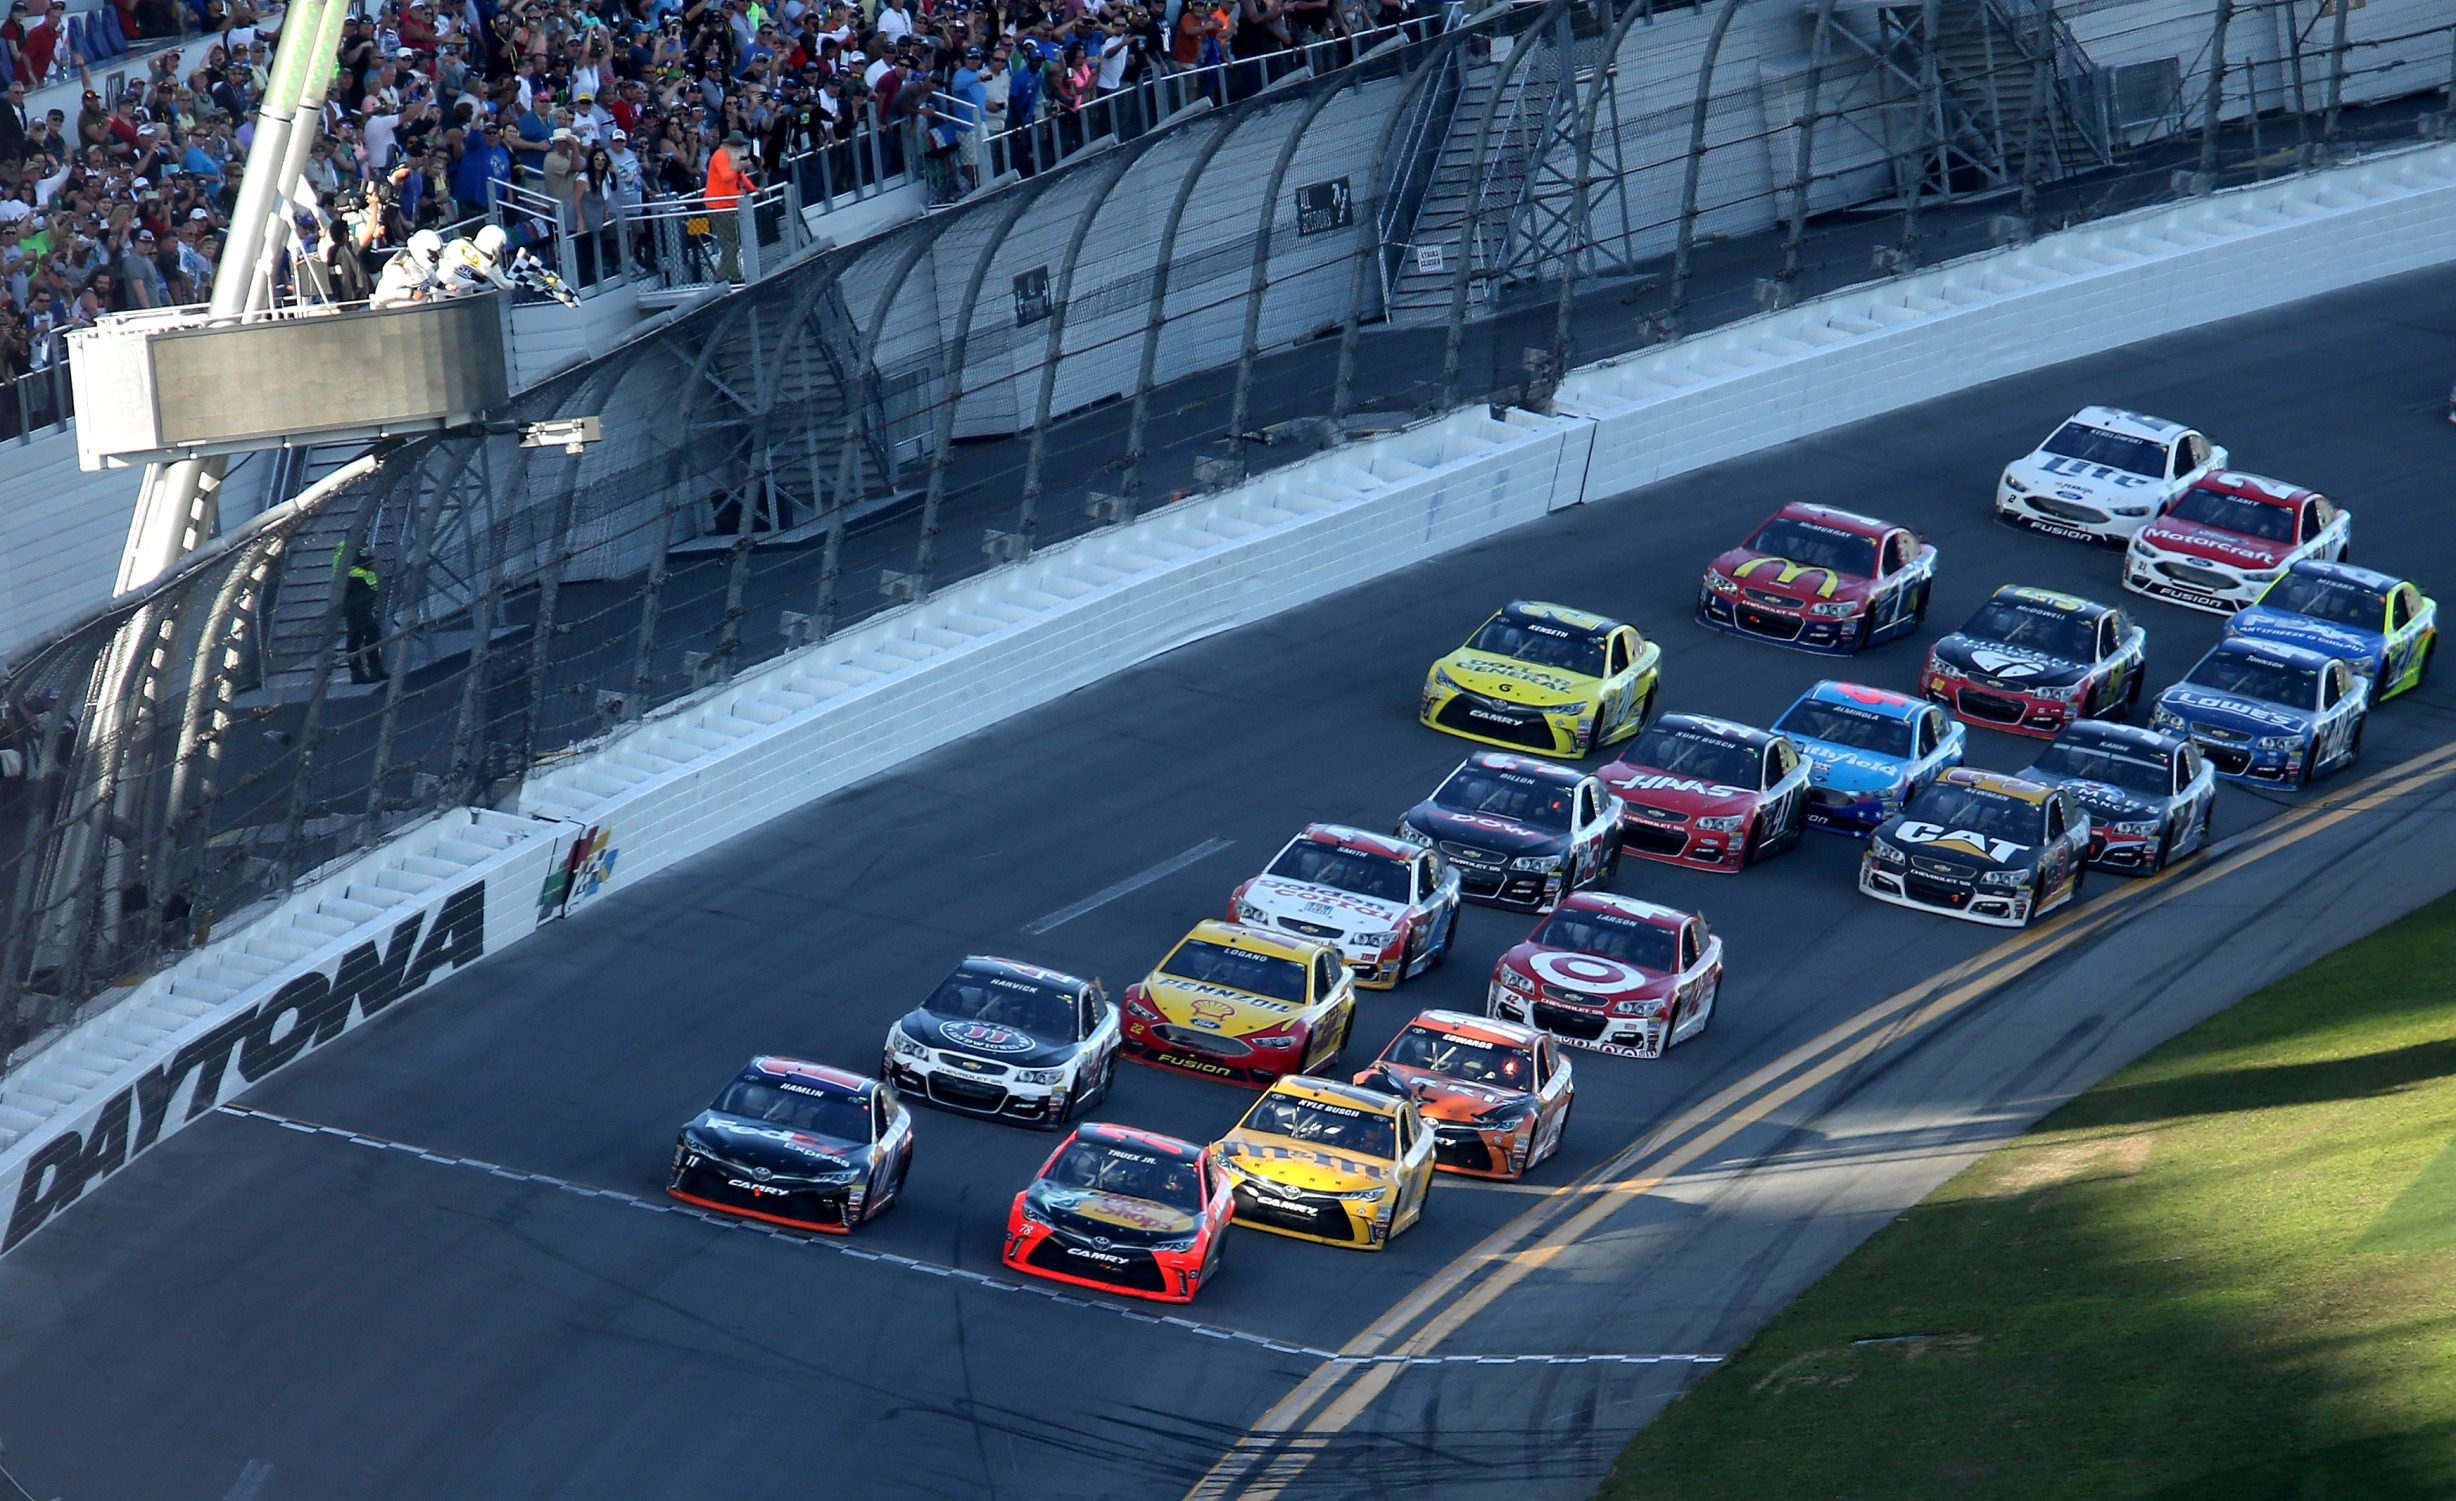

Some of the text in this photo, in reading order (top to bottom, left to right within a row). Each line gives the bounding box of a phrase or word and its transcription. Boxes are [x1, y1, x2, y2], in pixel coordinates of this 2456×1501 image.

[2089, 428, 2143, 445] KESELOWSKI
[2226, 495, 2260, 507] BLANEY
[1799, 521, 1853, 538] McMURRAY
[2030, 521, 2093, 542] FUSION
[2145, 528, 2275, 564] Motorcraft
[2316, 578, 2355, 591] MENARD
[2160, 588, 2223, 608] FUSION
[1742, 600, 1785, 615] CHEVROLET
[2016, 605, 2066, 620] McDOWELL
[1528, 624, 1569, 638] KENSETH
[2240, 627, 2305, 638] ANTIFREEZE
[2318, 637, 2366, 653] COOLANT
[2246, 655, 2285, 669] JOHNSON
[1832, 705, 1880, 721] ALMIROLA
[2179, 692, 2292, 726] LOWE'S
[1469, 709, 1523, 726] CAMRY
[1675, 731, 1736, 749] KURT BUSCH
[2099, 741, 2131, 752] KAHNE
[1500, 773, 1536, 785] DILLON
[1610, 775, 1745, 798] HAAS
[1964, 787, 2010, 801] NEWMAN
[1449, 813, 1536, 836] DOW
[1624, 815, 1671, 830] CHEVROLET
[1895, 821, 2031, 863] CAT
[1336, 846, 1369, 858] SMITH
[1449, 857, 1487, 871] EVROLET
[1910, 869, 1957, 885] CHEVROLET
[1596, 913, 1638, 928] LARSON
[1223, 947, 1269, 963] LOGANO
[990, 978, 1039, 994] HARVICK
[1157, 978, 1291, 1013] PENNZOIL
[1505, 994, 1519, 1005] 42
[1541, 997, 1590, 1014] CHEVROLET
[1130, 1022, 1145, 1035] 22
[1442, 1033, 1494, 1050] EDWARDS
[0, 880, 485, 1256] DAYTONA
[901, 1062, 912, 1071] 4
[1158, 1053, 1232, 1077] FUSION
[936, 1066, 987, 1082] CHEVROLET
[780, 1082, 824, 1098] HAMLIN
[1298, 1099, 1360, 1118] KYLE BUSCH
[685, 1155, 700, 1168] 11
[784, 1142, 850, 1168] Express
[1108, 1149, 1141, 1163] TRUEX
[728, 1178, 790, 1196] CAMRY
[1257, 1196, 1319, 1215] CAMRY
[1094, 1206, 1173, 1230] Shops
[1019, 1223, 1034, 1235] 78
[1067, 1247, 1129, 1265] CAMRY
